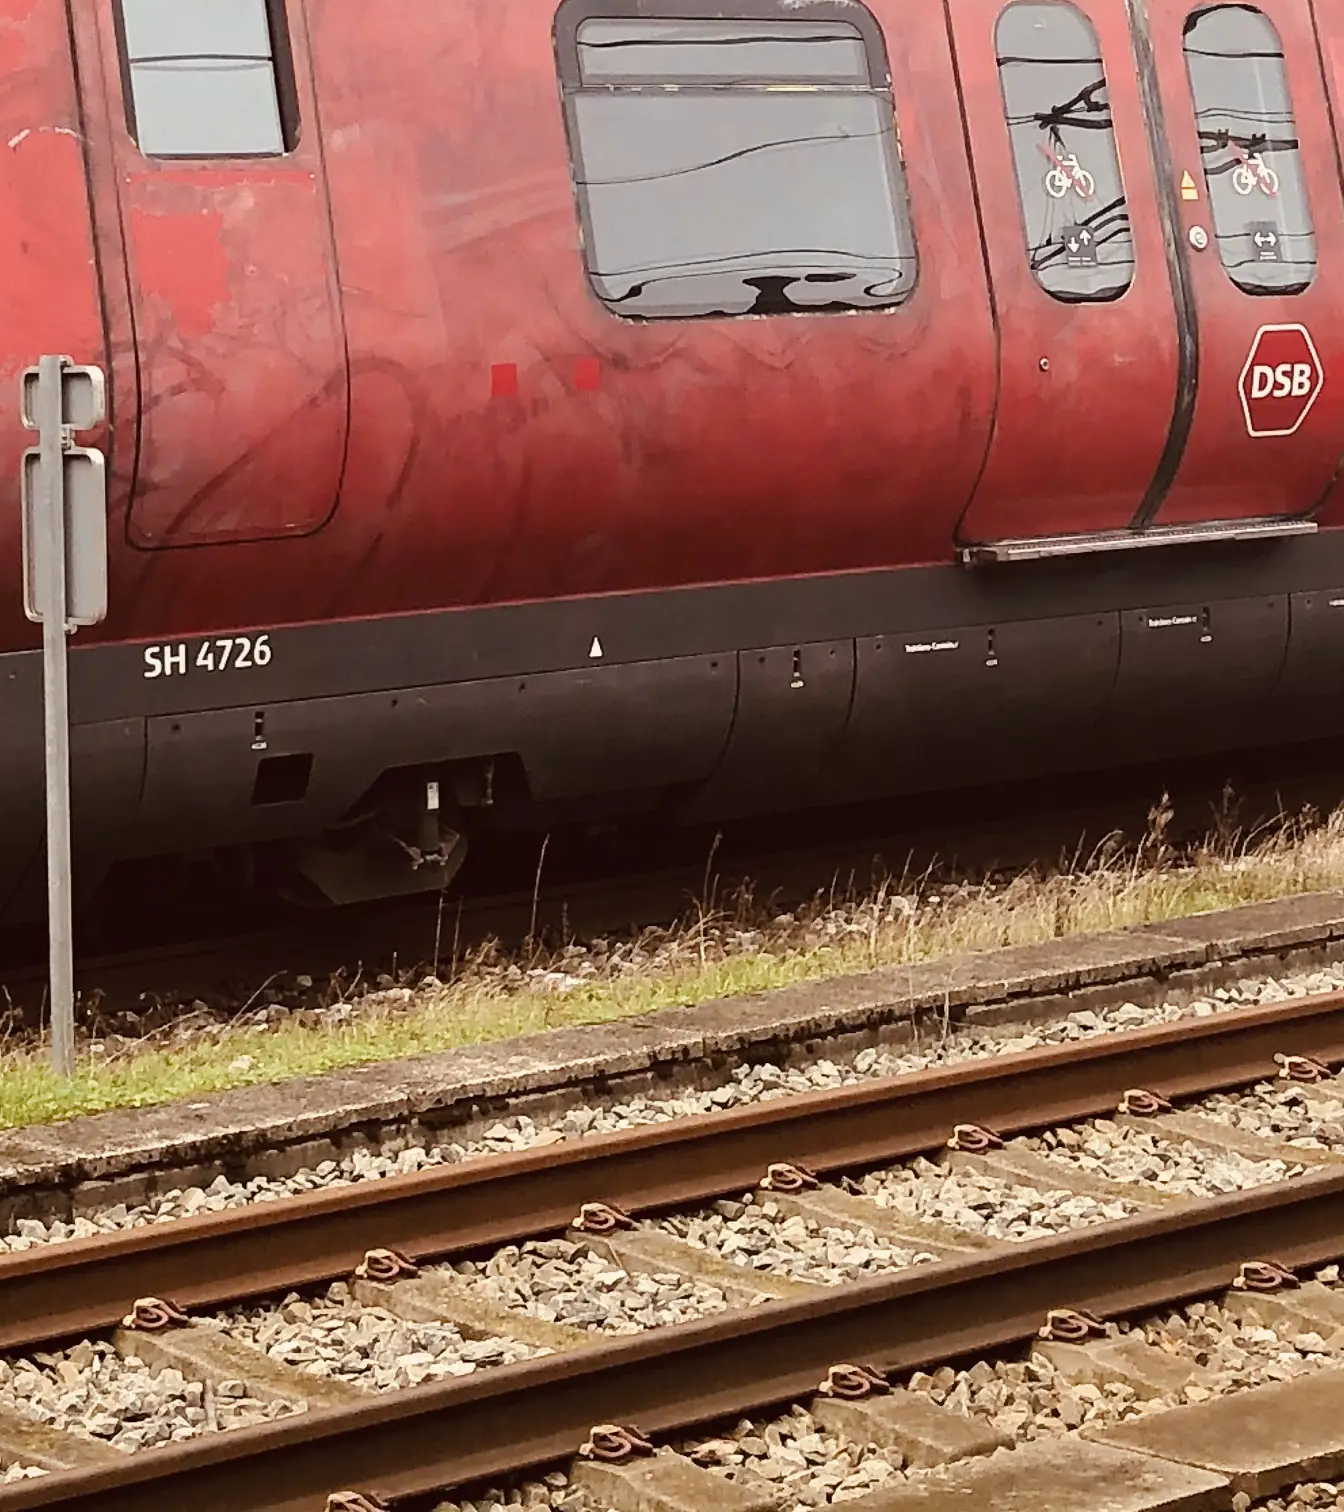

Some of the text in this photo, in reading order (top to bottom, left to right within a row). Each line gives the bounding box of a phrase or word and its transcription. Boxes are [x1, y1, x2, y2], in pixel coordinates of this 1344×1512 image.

[1251, 365, 1311, 399] DSB
[143, 636, 272, 678] SH 4726
